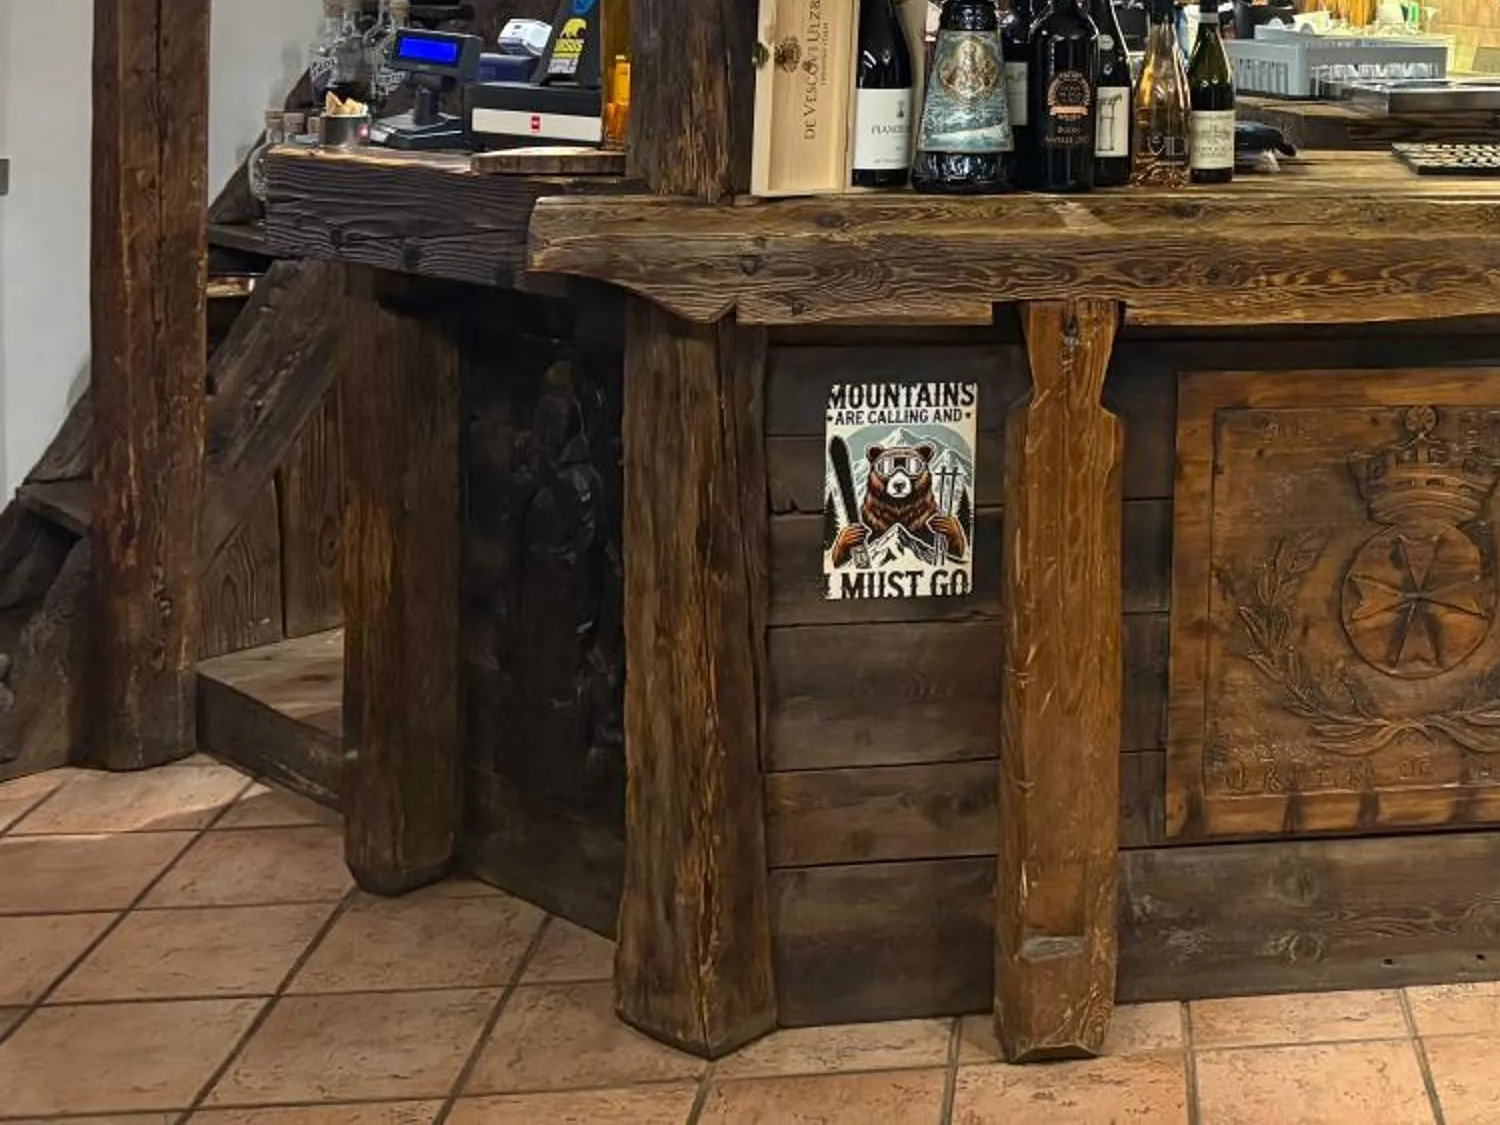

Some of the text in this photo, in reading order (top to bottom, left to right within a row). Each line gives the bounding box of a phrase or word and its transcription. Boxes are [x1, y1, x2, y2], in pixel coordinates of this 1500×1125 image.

[827, 382, 975, 410] MOUNTAINS
[835, 407, 962, 425] ARE CALLING AND
[840, 570, 925, 600] MUST
[929, 568, 970, 597] GO
